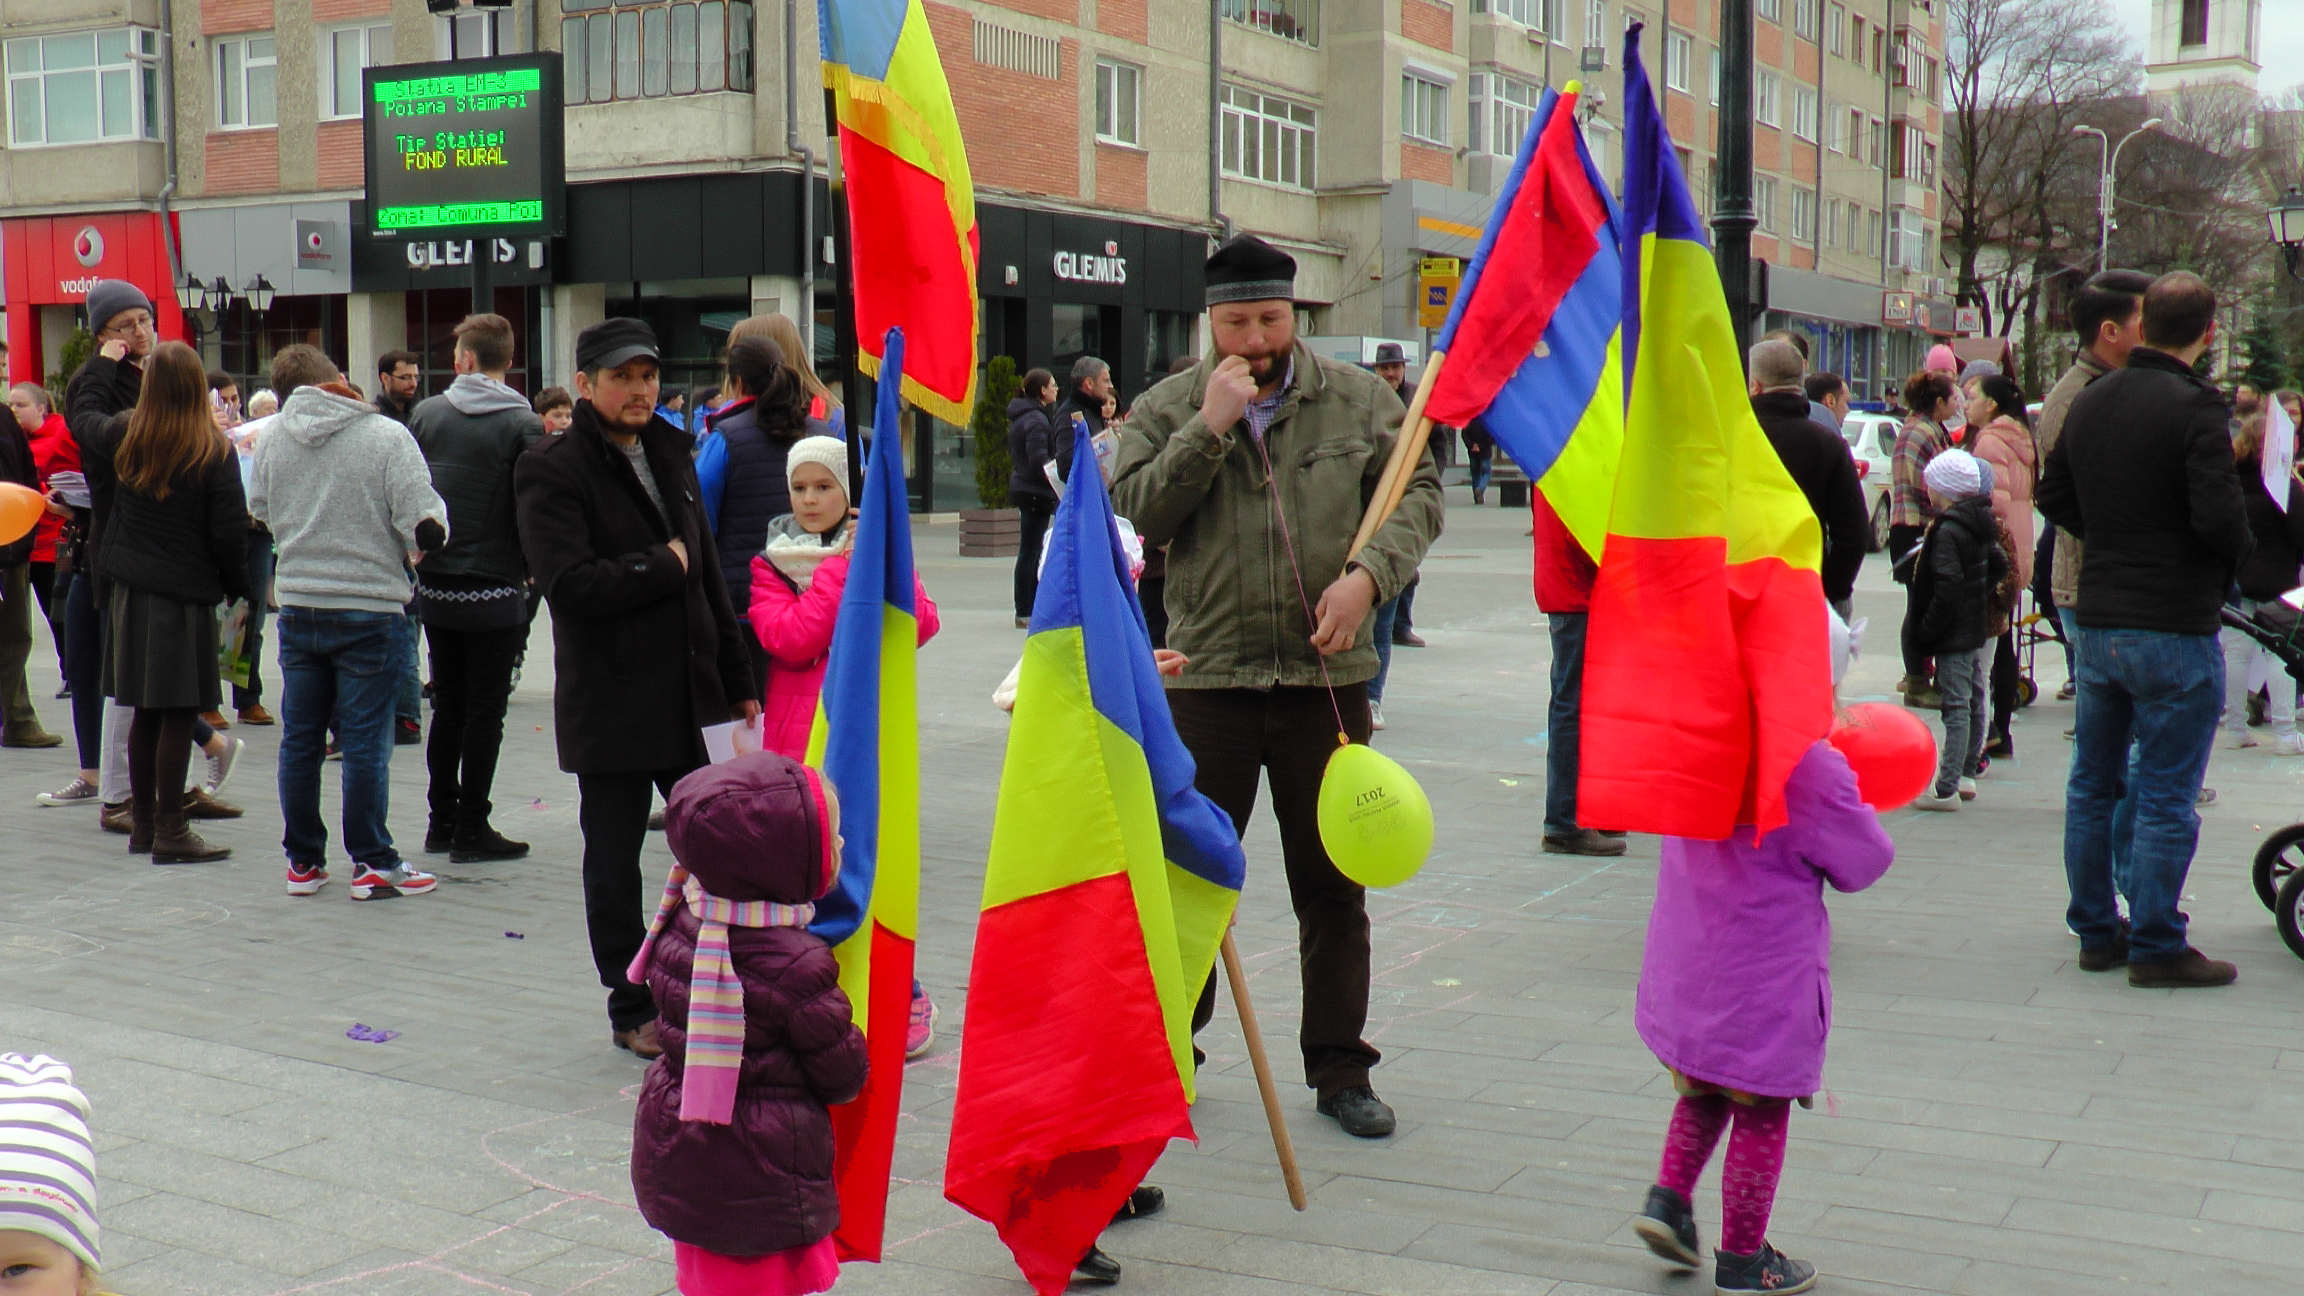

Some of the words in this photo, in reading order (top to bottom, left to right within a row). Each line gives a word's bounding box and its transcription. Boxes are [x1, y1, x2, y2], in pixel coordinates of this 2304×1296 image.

[395, 78, 455, 98] Statia
[466, 71, 507, 92] EM-3
[385, 99, 447, 118] Poiana
[456, 91, 528, 112] Stampei
[396, 133, 427, 153] Tip
[405, 151, 447, 170] FOND
[456, 147, 508, 167] RURAL
[438, 203, 499, 223] Comuna
[1053, 250, 1127, 284] GLEMIS
[1888, 308, 1907, 316] ING
[1356, 786, 1385, 806] 2017
